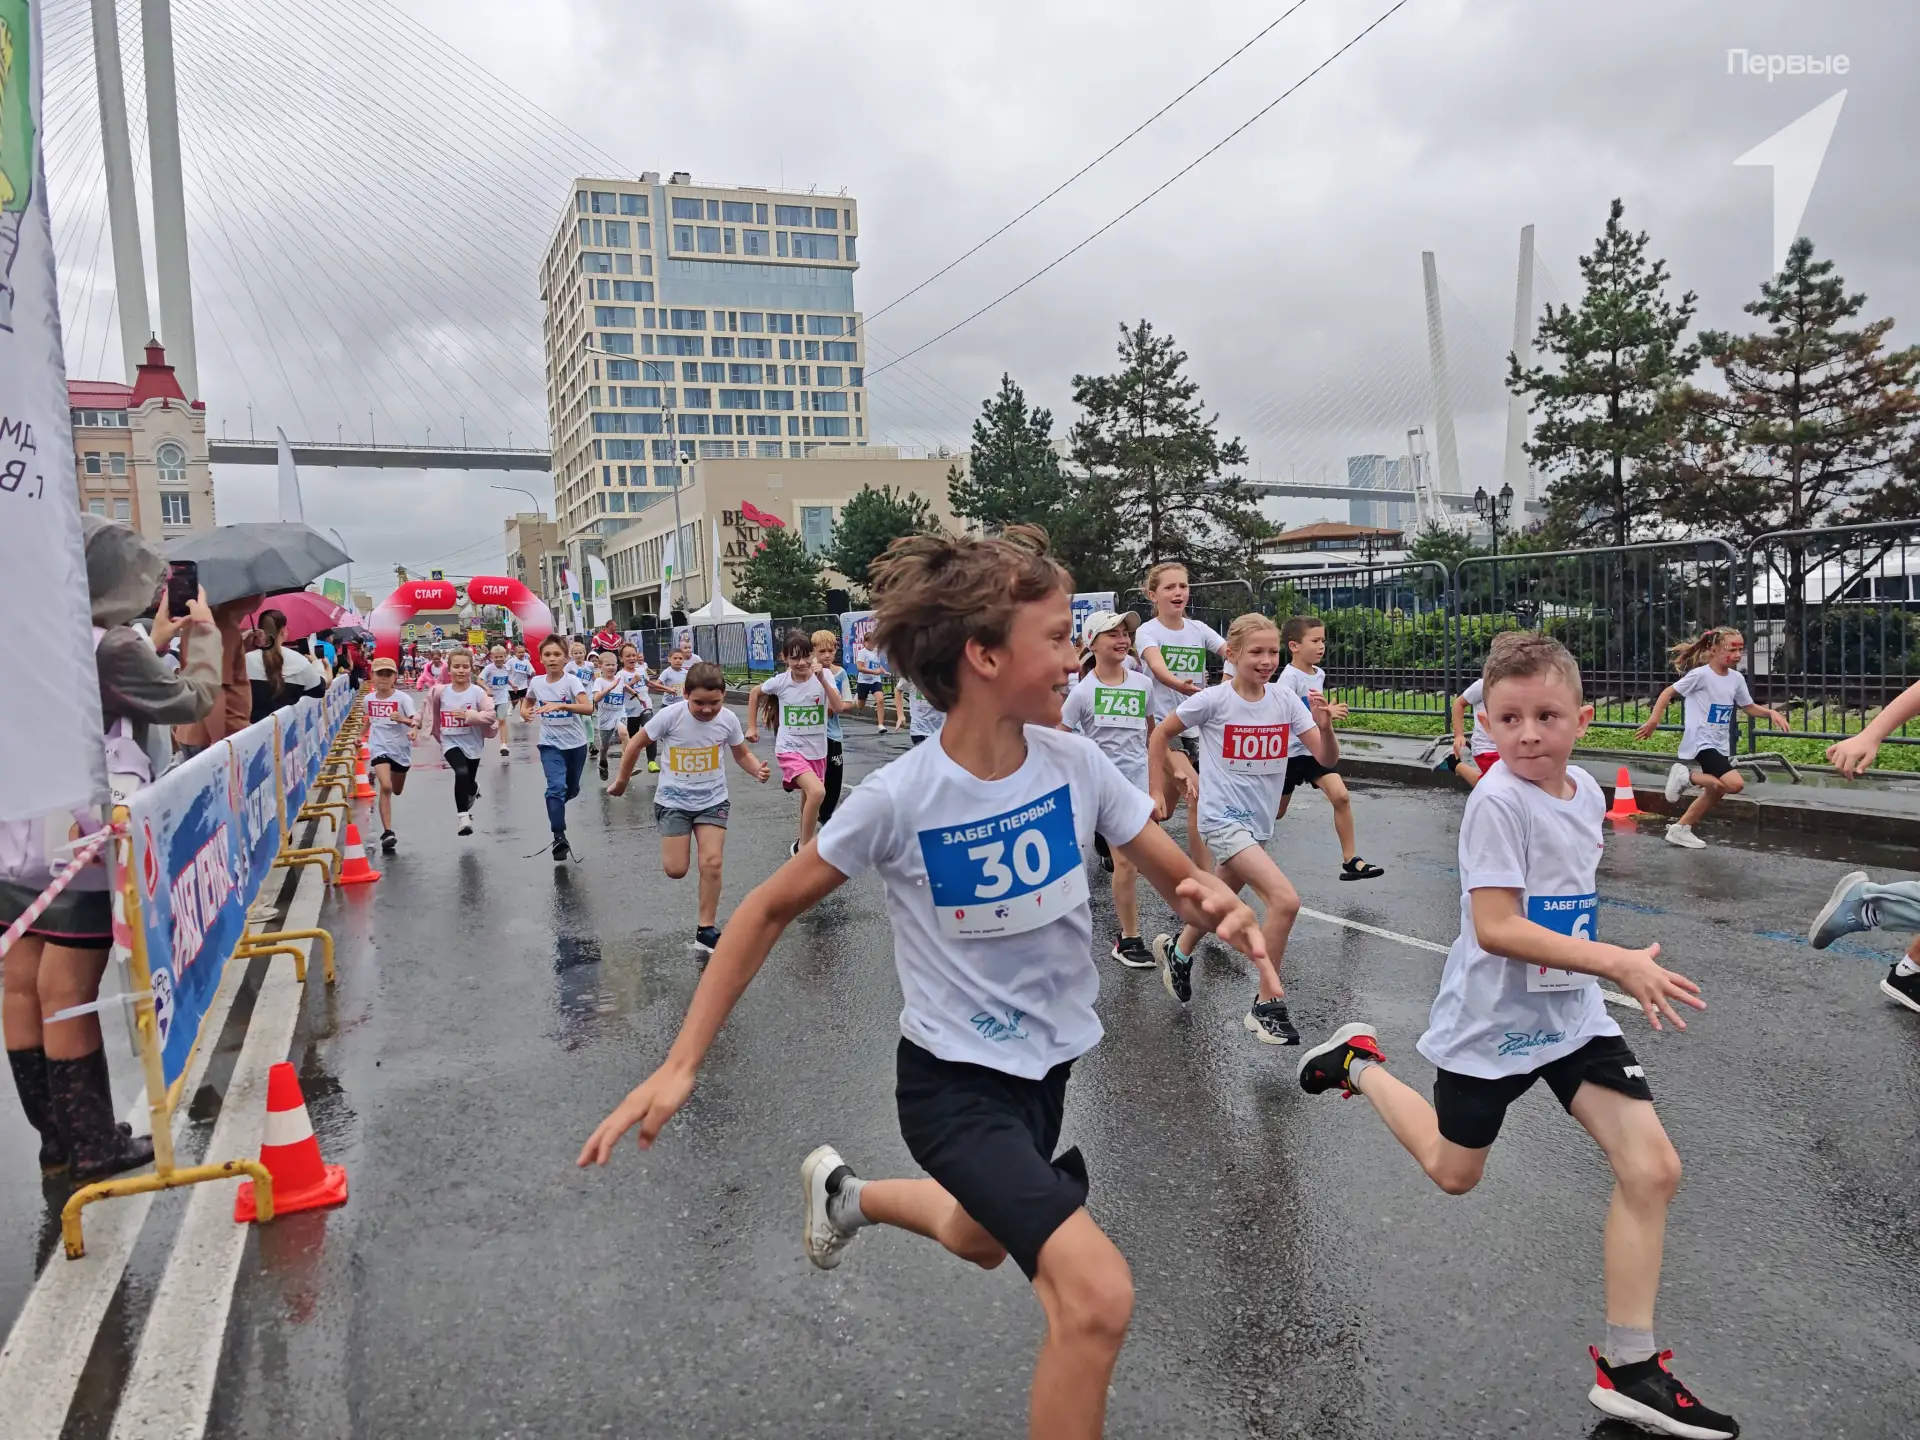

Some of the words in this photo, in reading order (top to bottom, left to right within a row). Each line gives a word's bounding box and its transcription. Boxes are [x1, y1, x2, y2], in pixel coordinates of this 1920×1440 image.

[722, 510, 746, 526] BE
[735, 527, 760, 541] NU
[723, 542, 750, 558] AR
[415, 589, 442, 600] СТАРТ
[482, 585, 509, 596] СТАРТ
[1166, 653, 1199, 671] 750
[371, 705, 393, 716] 1150
[1101, 695, 1140, 715] 748
[787, 711, 820, 725] 840
[1715, 710, 1732, 723] 14
[1232, 735, 1282, 758] 1010
[676, 753, 713, 771] 1651
[941, 823, 996, 845] ЗАБЕГ
[999, 797, 1057, 833] ПЕРВЫХ
[968, 828, 1050, 899] 30
[1543, 900, 1578, 911] ЗАБЕГ
